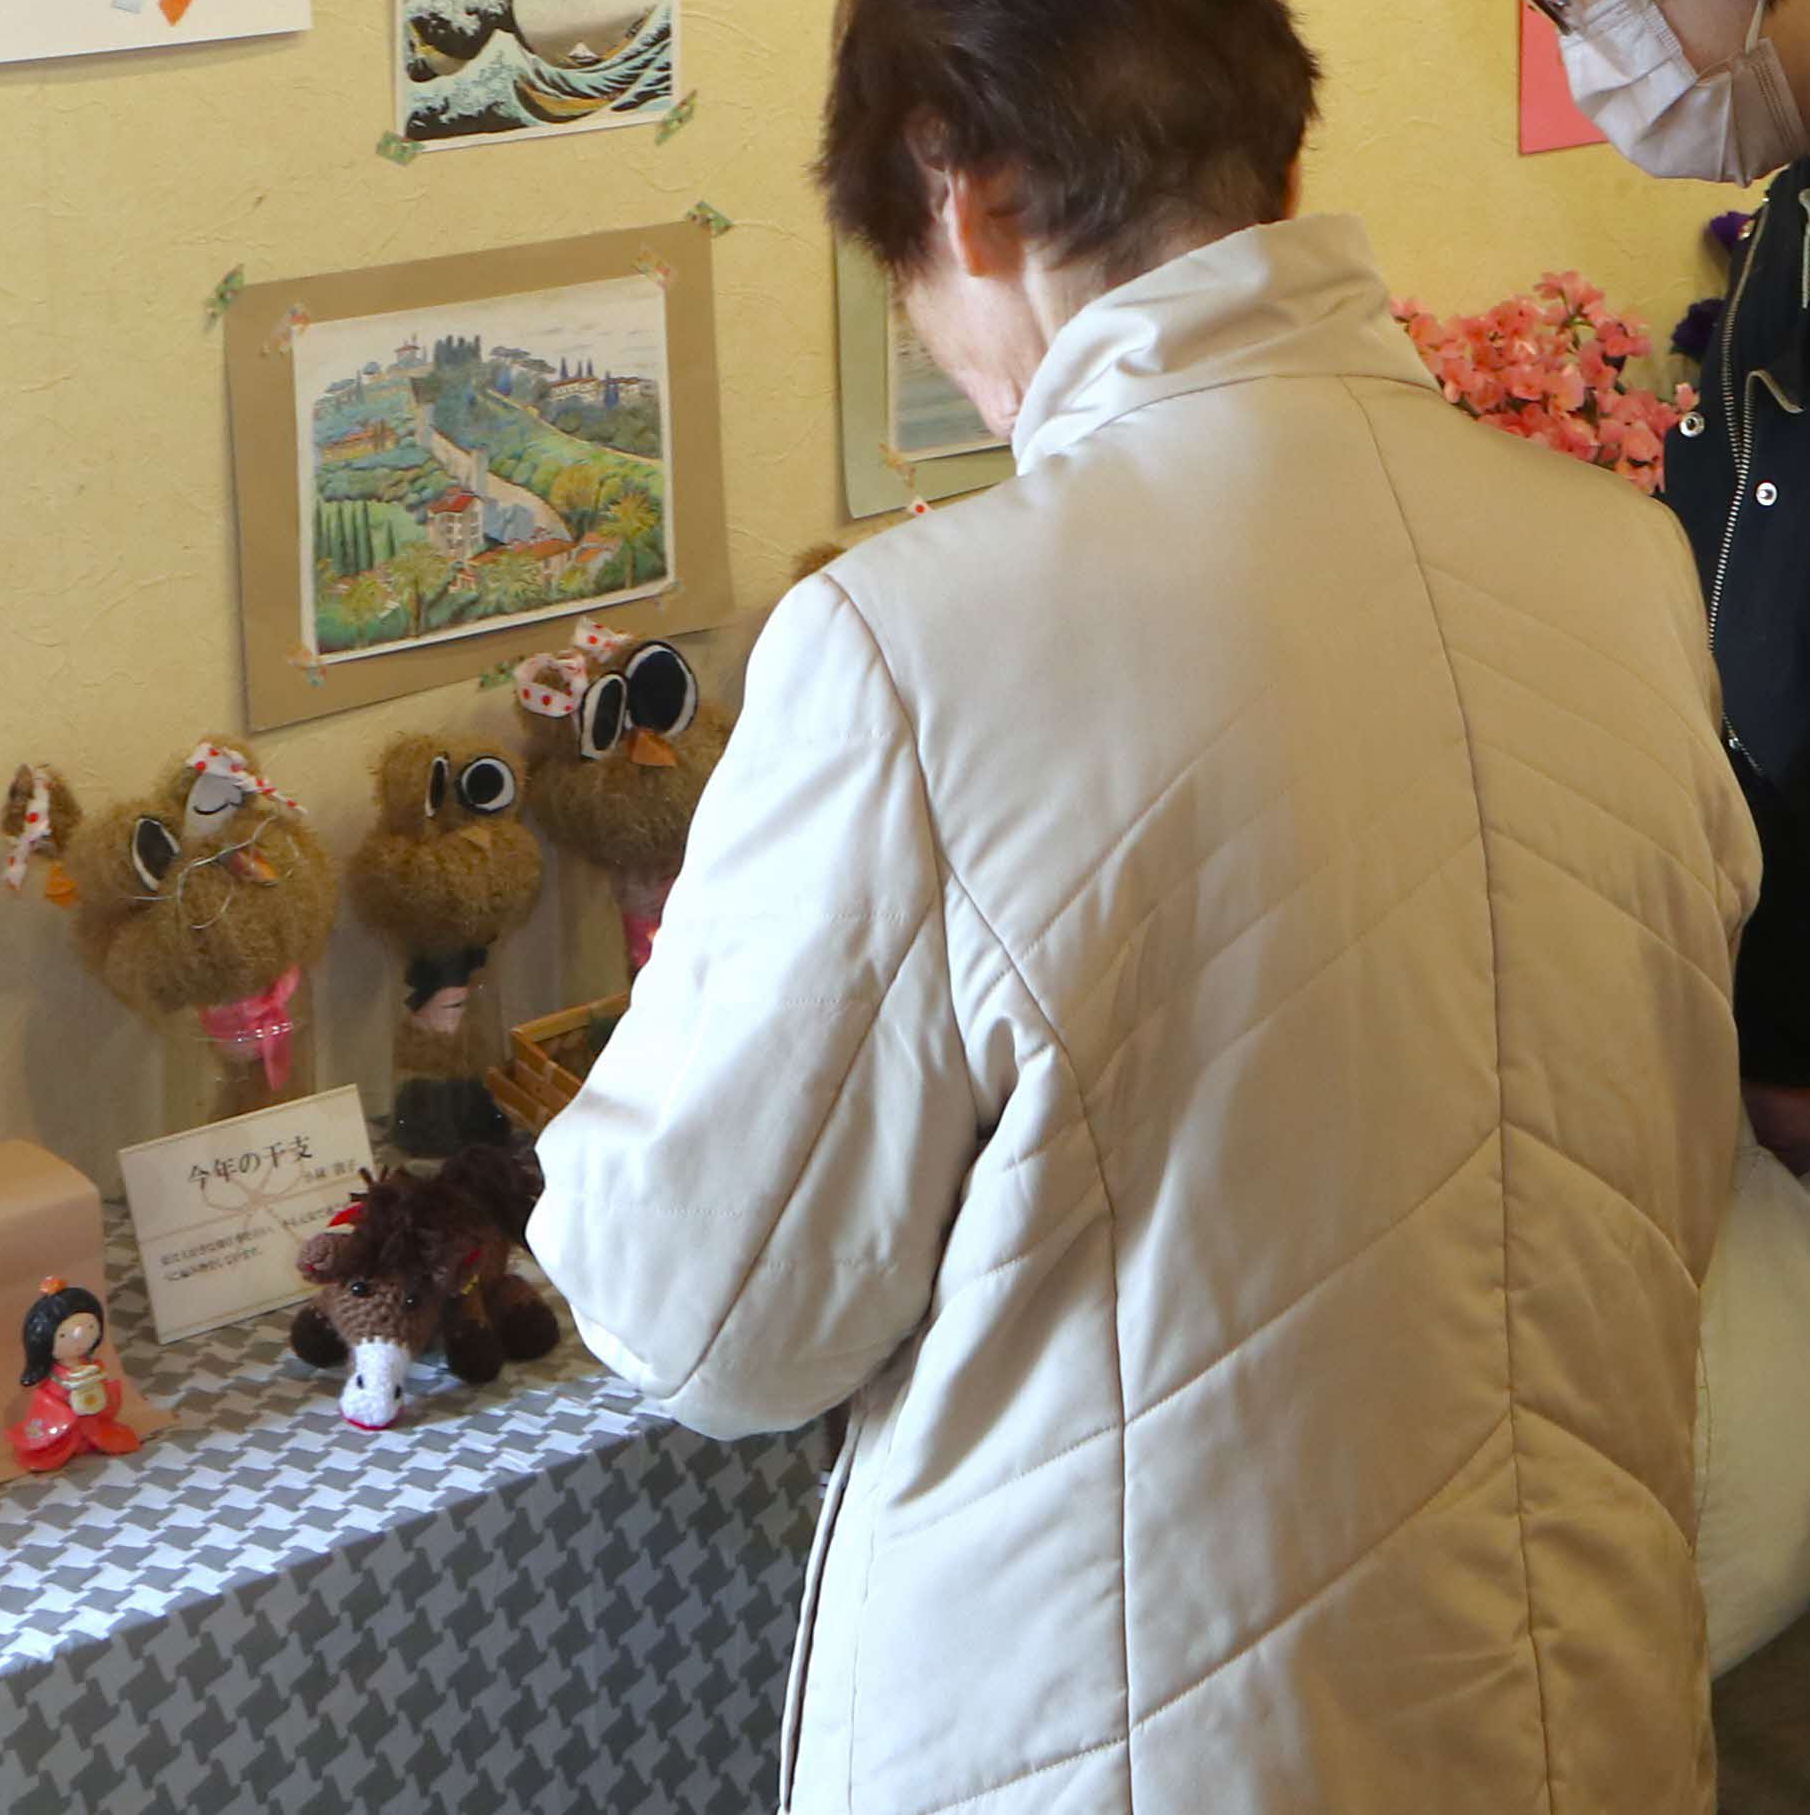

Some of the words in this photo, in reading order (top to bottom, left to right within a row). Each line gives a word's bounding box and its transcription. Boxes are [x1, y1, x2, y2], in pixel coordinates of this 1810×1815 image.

[190, 1135, 313, 1190] 今年の干支
